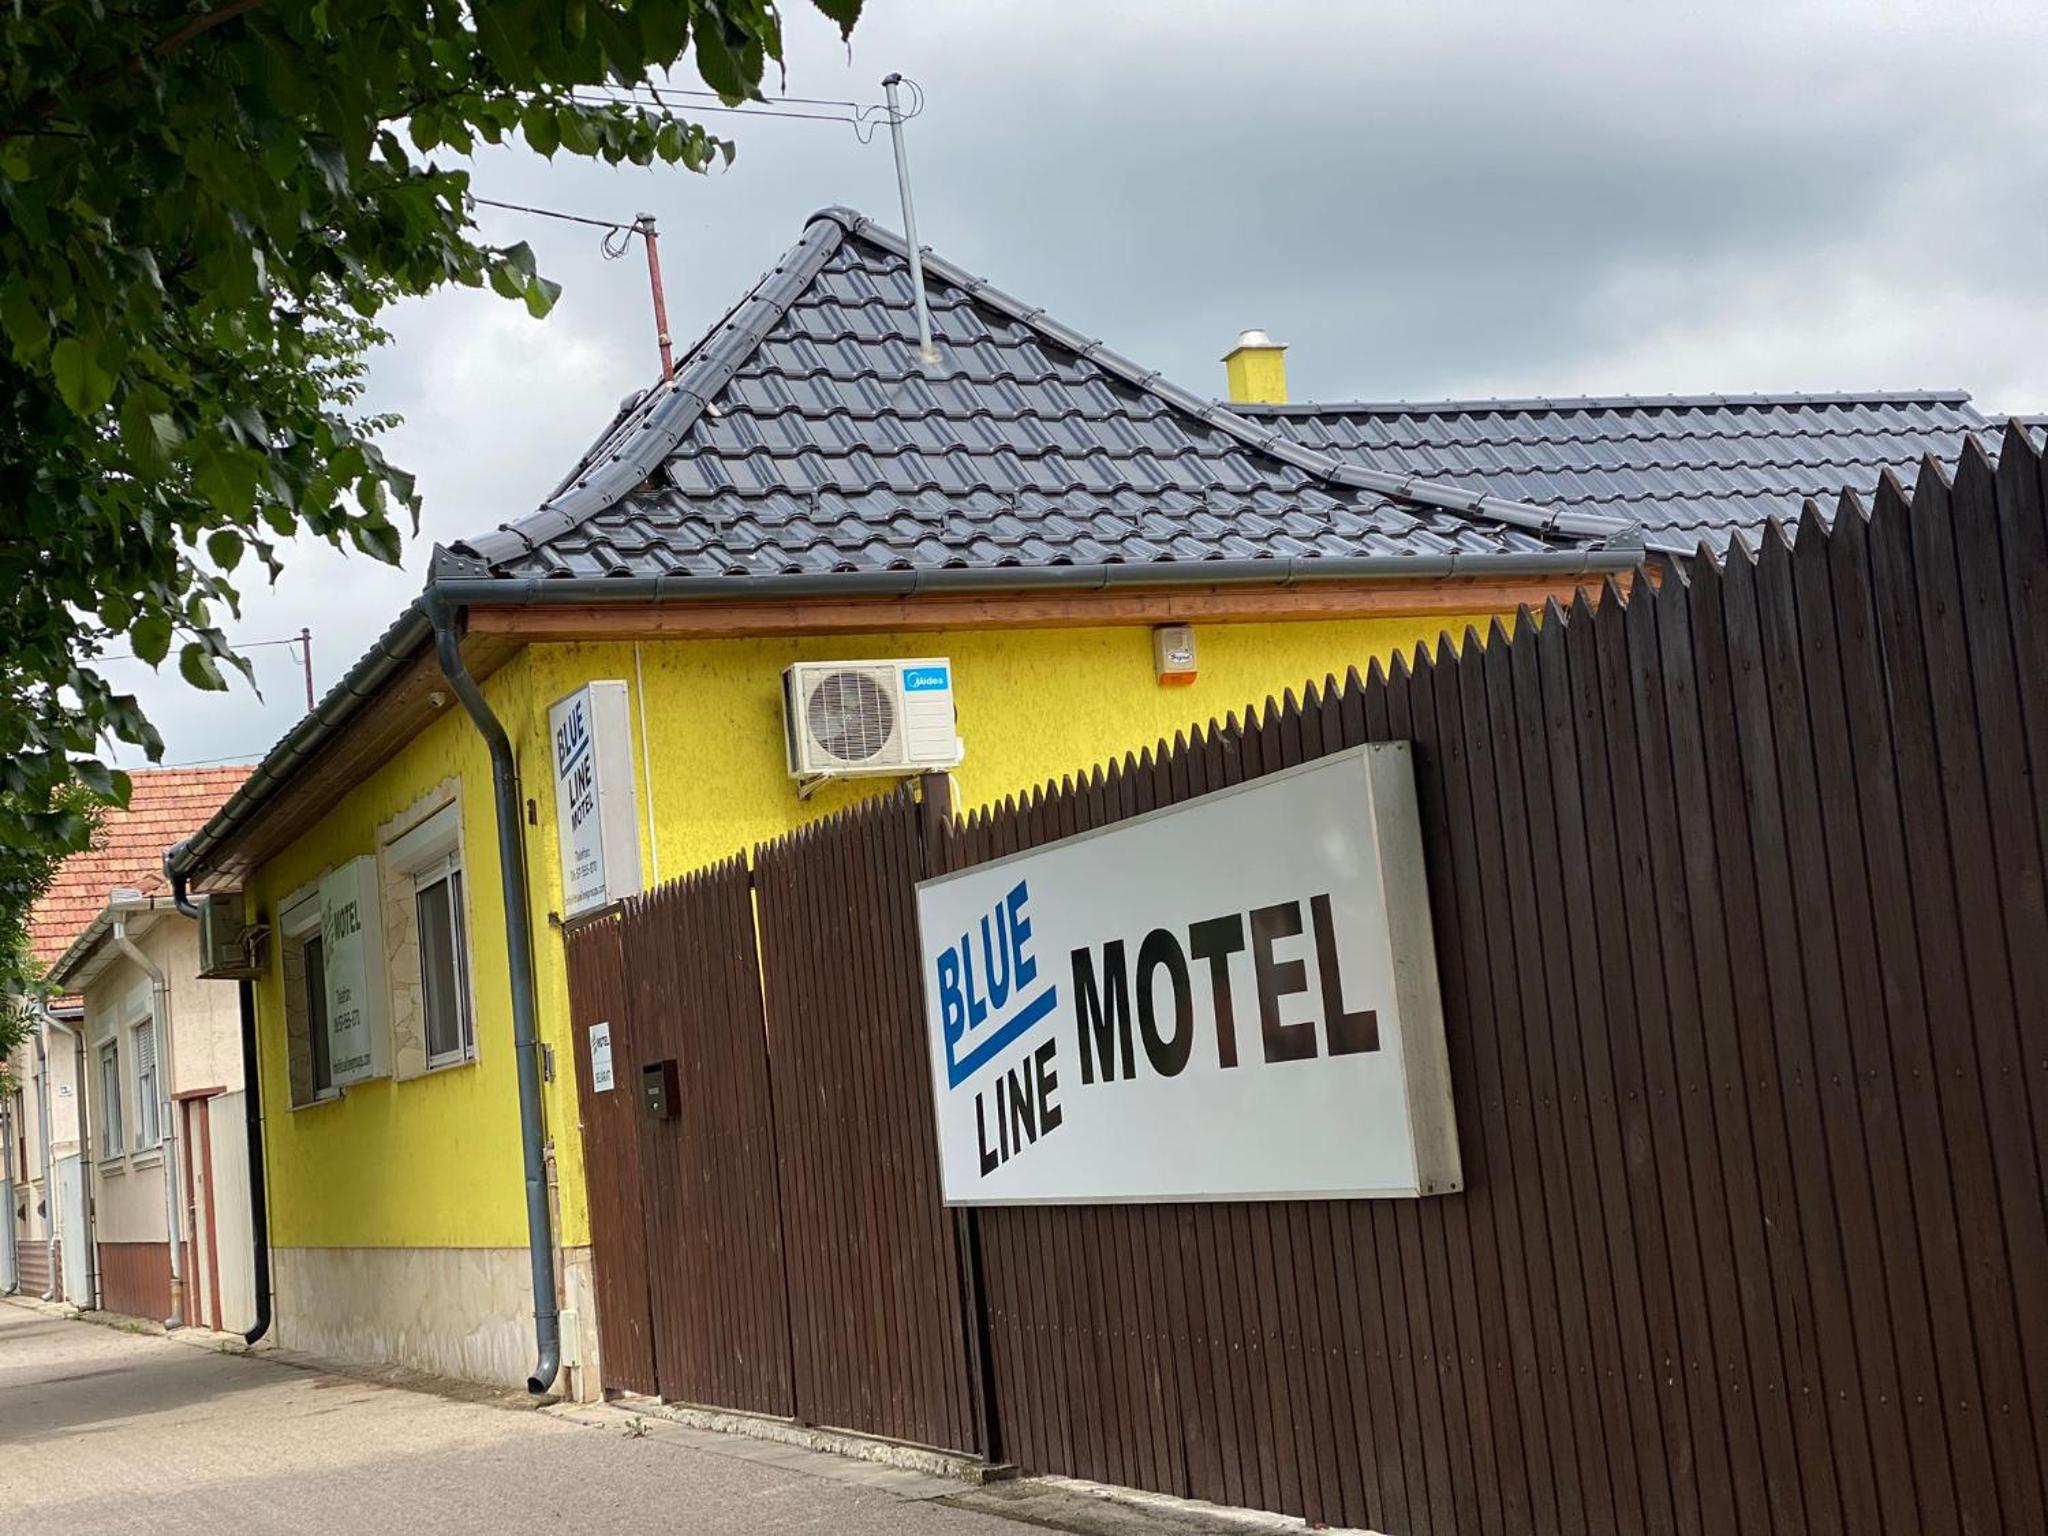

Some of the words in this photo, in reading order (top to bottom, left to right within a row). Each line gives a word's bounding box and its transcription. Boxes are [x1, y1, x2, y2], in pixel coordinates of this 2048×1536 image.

[557, 699, 585, 763] BLUE
[567, 752, 592, 809] LINE
[571, 790, 594, 832] MOTEL
[333, 898, 361, 941] MOTEL
[936, 878, 1037, 1046] BLUE
[1070, 893, 1381, 1086] MOTEL
[974, 1036, 1063, 1179] LINE
